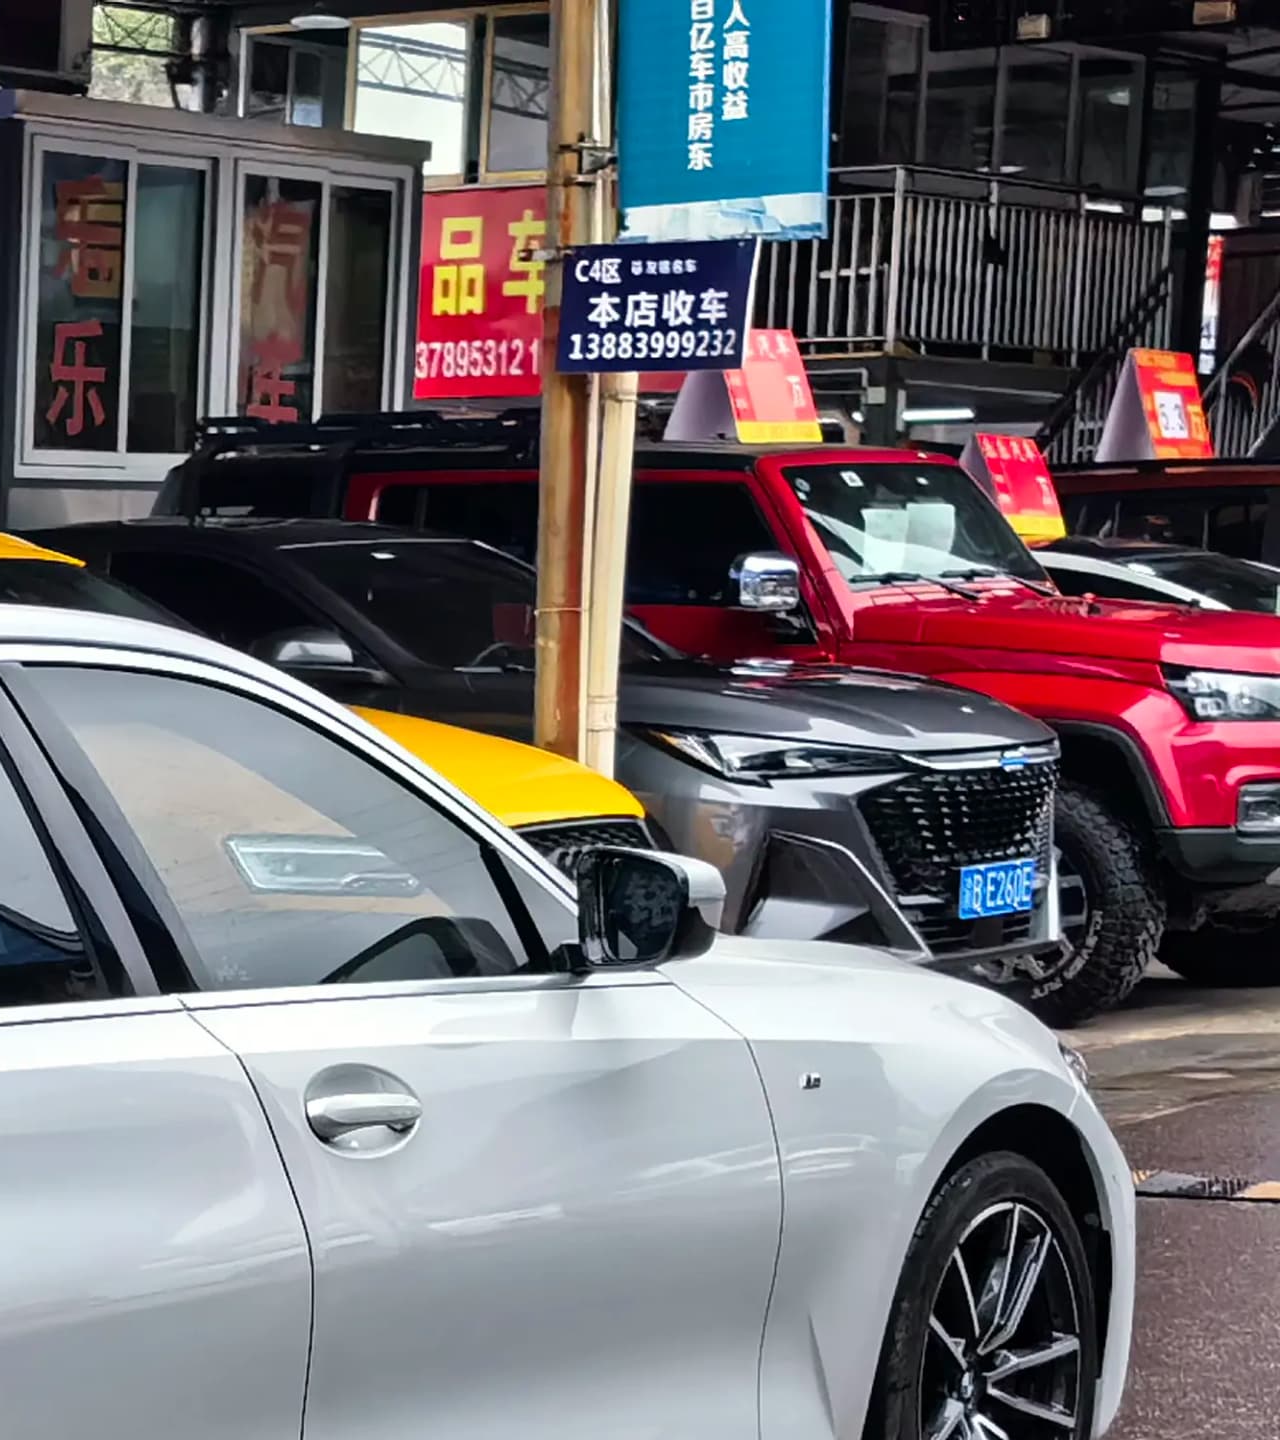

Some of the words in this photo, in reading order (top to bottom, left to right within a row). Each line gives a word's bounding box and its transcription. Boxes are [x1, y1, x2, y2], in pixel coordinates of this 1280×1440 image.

[575, 258, 622, 284] C4区
[587, 288, 729, 329] 本店收车
[568, 328, 736, 360] 13883999232
